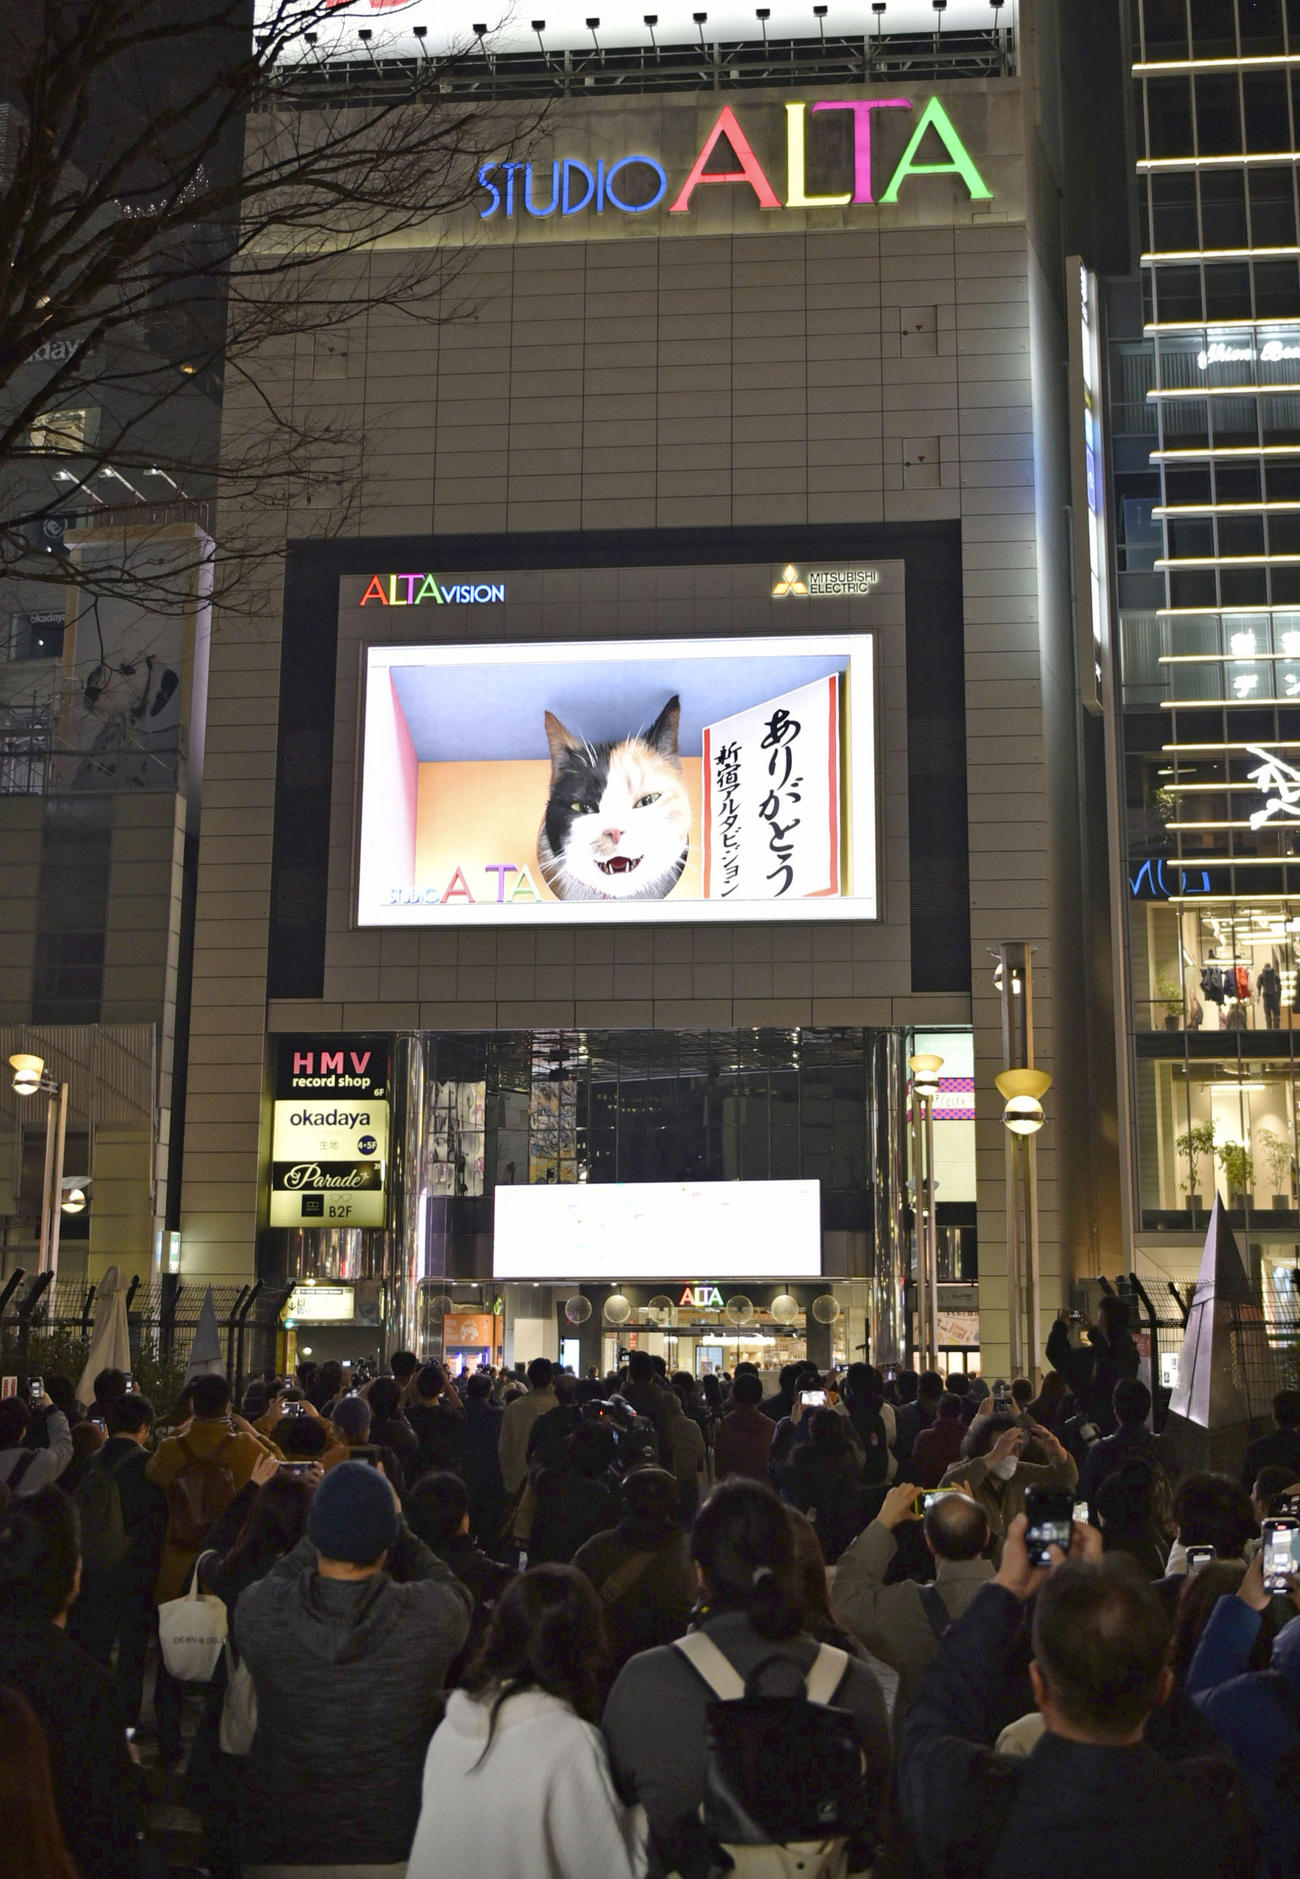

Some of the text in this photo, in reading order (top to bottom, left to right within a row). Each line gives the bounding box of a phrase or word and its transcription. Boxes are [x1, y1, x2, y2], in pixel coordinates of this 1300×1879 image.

[477, 96, 995, 220] STUDIO ALTA
[809, 571, 877, 583] MITSUBISHI
[809, 583, 868, 594] ELECTRIC
[759, 708, 804, 898] ありがとう
[714, 741, 742, 898] 新宿アルタビジョン
[440, 863, 543, 904] ATA
[292, 1051, 372, 1074] HMV
[292, 1075, 371, 1089] record shop
[373, 1088, 384, 1097] 6F
[289, 1109, 371, 1129] okadaya
[284, 1163, 362, 1190] Parade
[329, 1206, 352, 1218] B2F
[680, 1286, 725, 1306] ALTA
